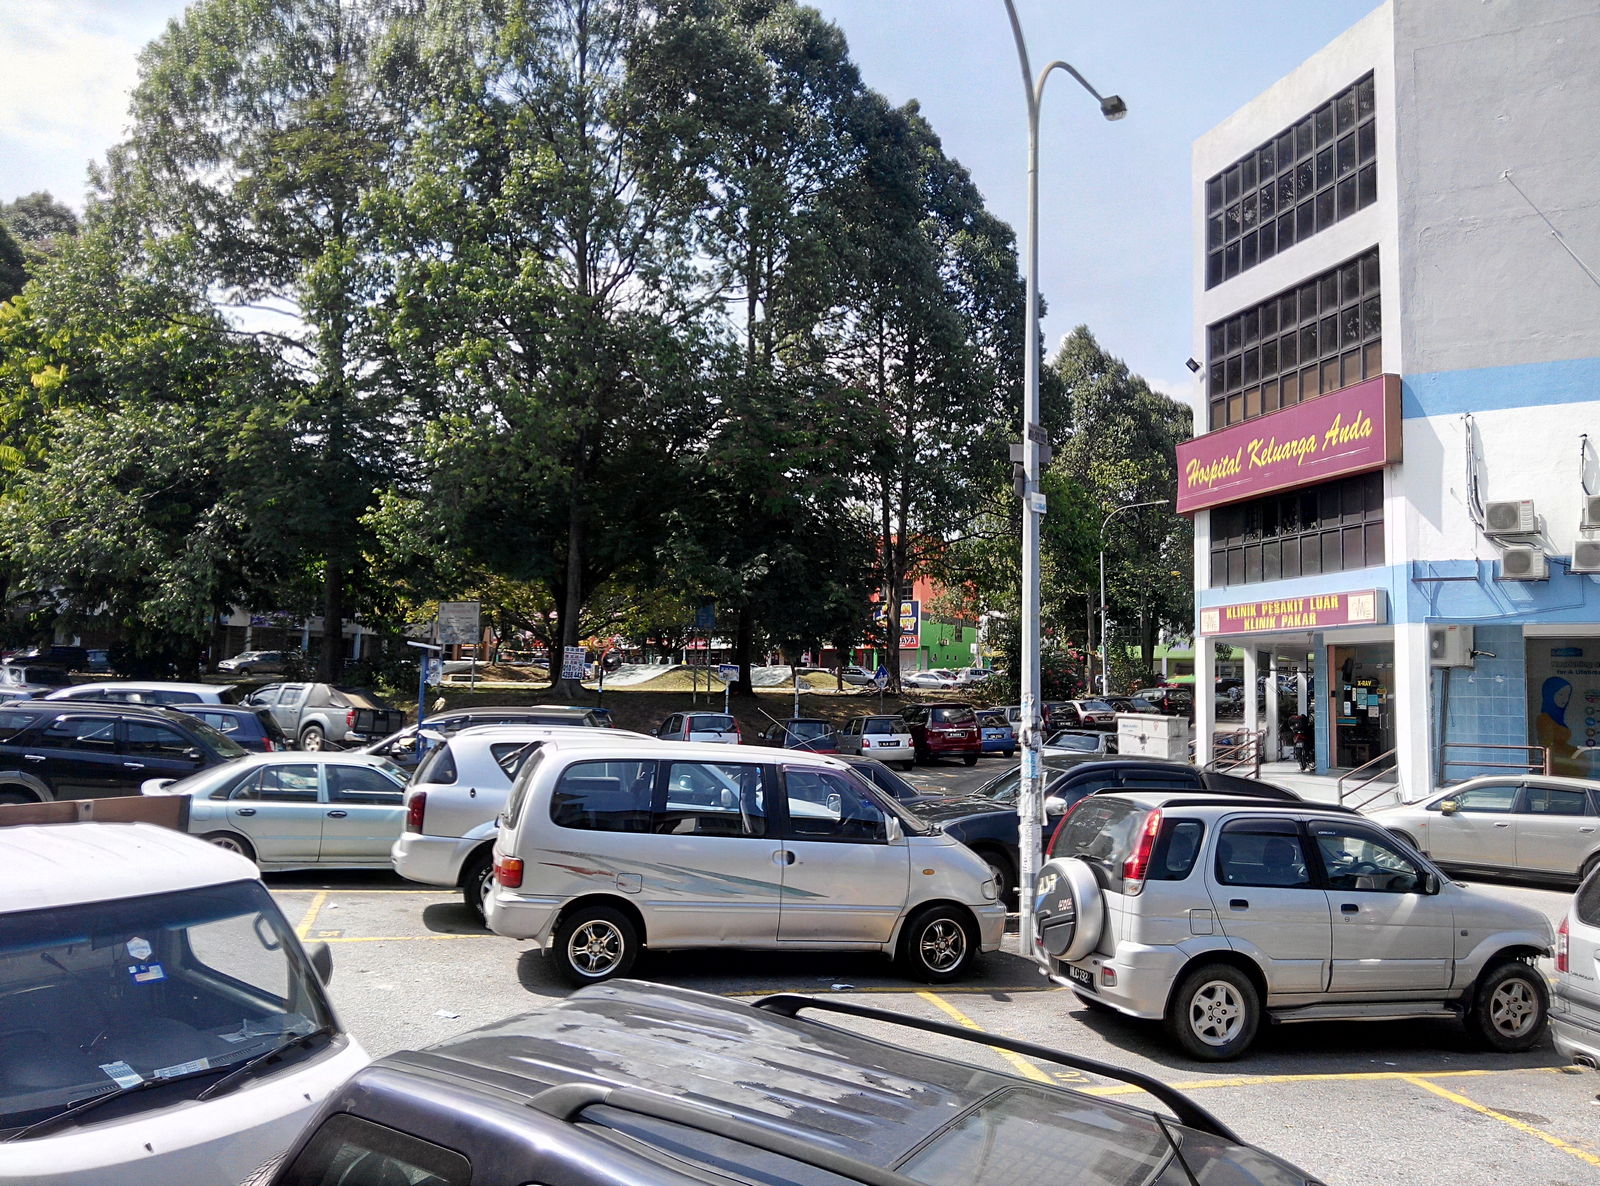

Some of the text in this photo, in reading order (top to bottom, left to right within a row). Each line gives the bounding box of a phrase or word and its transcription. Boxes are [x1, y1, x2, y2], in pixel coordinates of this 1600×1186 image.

[1186, 410, 1373, 489] Hospital Keluarga Anda
[1226, 604, 1257, 620] KLINIK
[1261, 597, 1304, 616] PESAKIT
[1309, 595, 1339, 611] LUAR
[1243, 612, 1317, 631] KLINIK PAKAR
